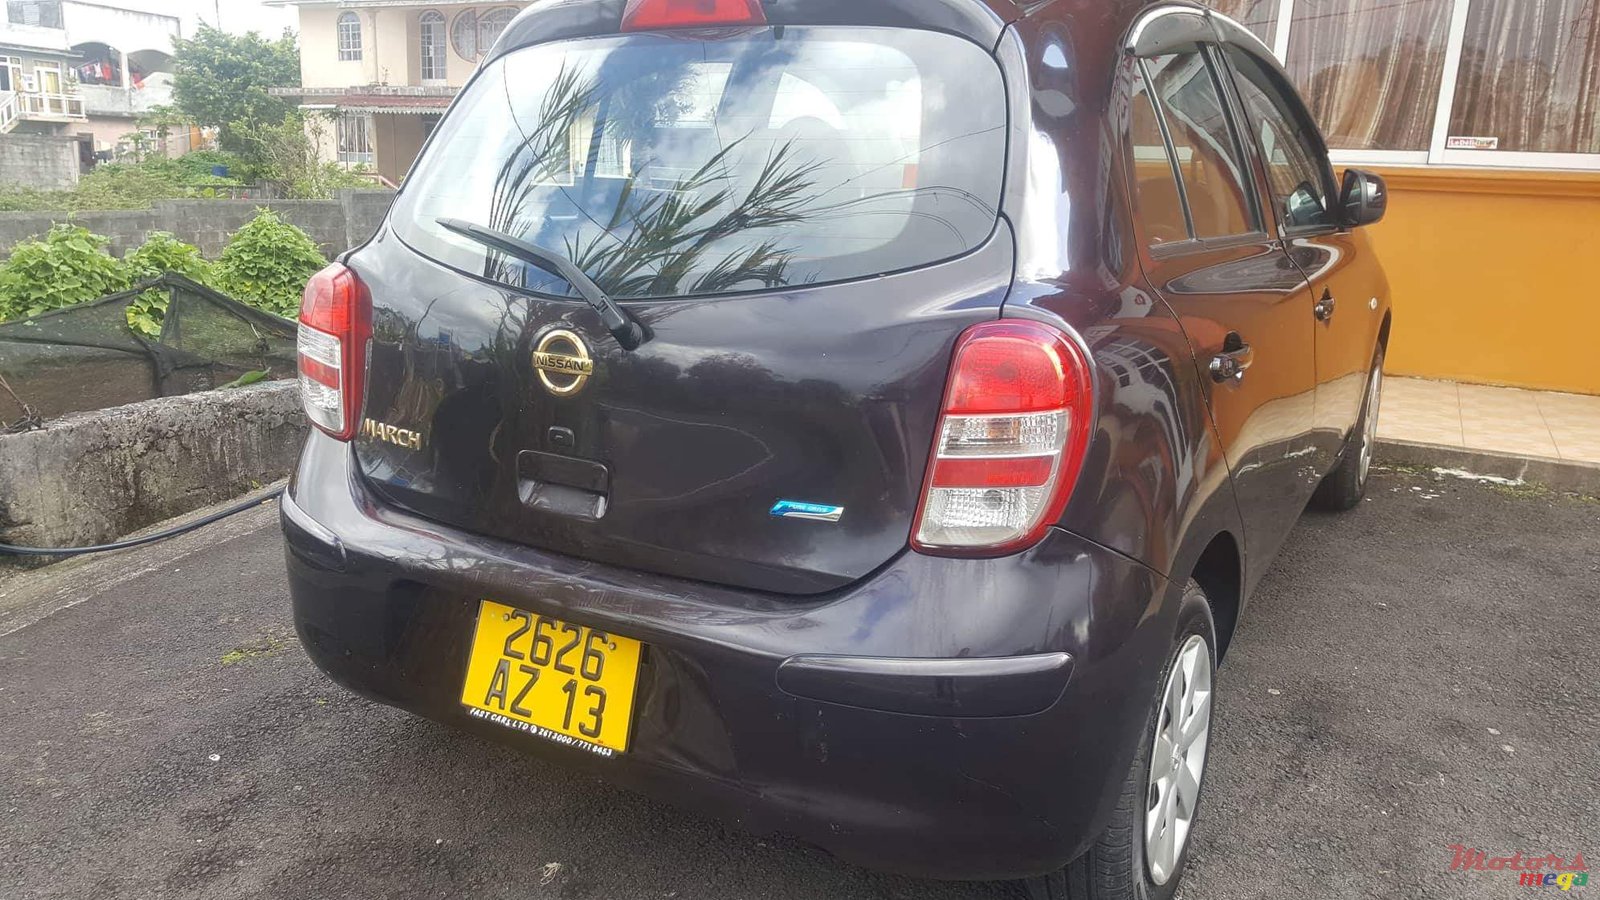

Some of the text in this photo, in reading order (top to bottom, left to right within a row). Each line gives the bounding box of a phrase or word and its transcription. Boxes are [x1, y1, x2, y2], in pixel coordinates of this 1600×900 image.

[536, 353, 584, 371] NISSAN
[362, 417, 421, 451] MARCH
[503, 608, 609, 682] 2626
[484, 658, 607, 738] AZ 13
[470, 707, 491, 719] FAST
[490, 713, 511, 727] CARS
